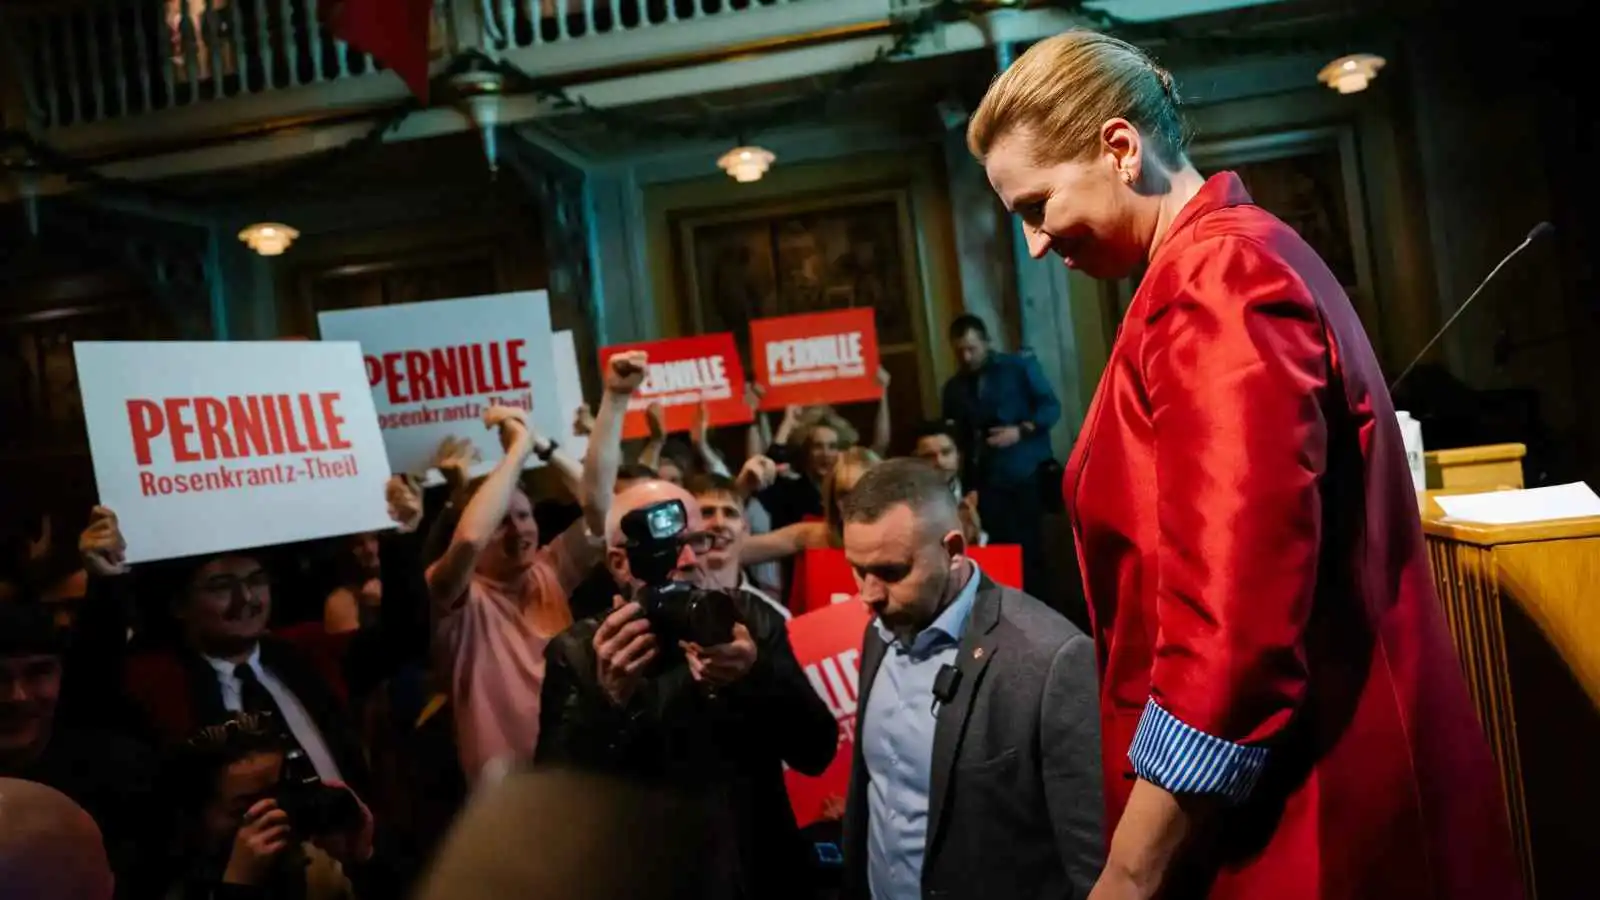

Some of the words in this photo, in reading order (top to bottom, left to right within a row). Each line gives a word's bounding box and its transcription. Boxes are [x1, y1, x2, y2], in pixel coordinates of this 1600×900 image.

[640, 355, 729, 392] ERNILLE
[765, 332, 864, 376] PERNILLE
[126, 391, 352, 466] PERNILLE
[139, 454, 359, 497] Rosenkrantz-Theil
